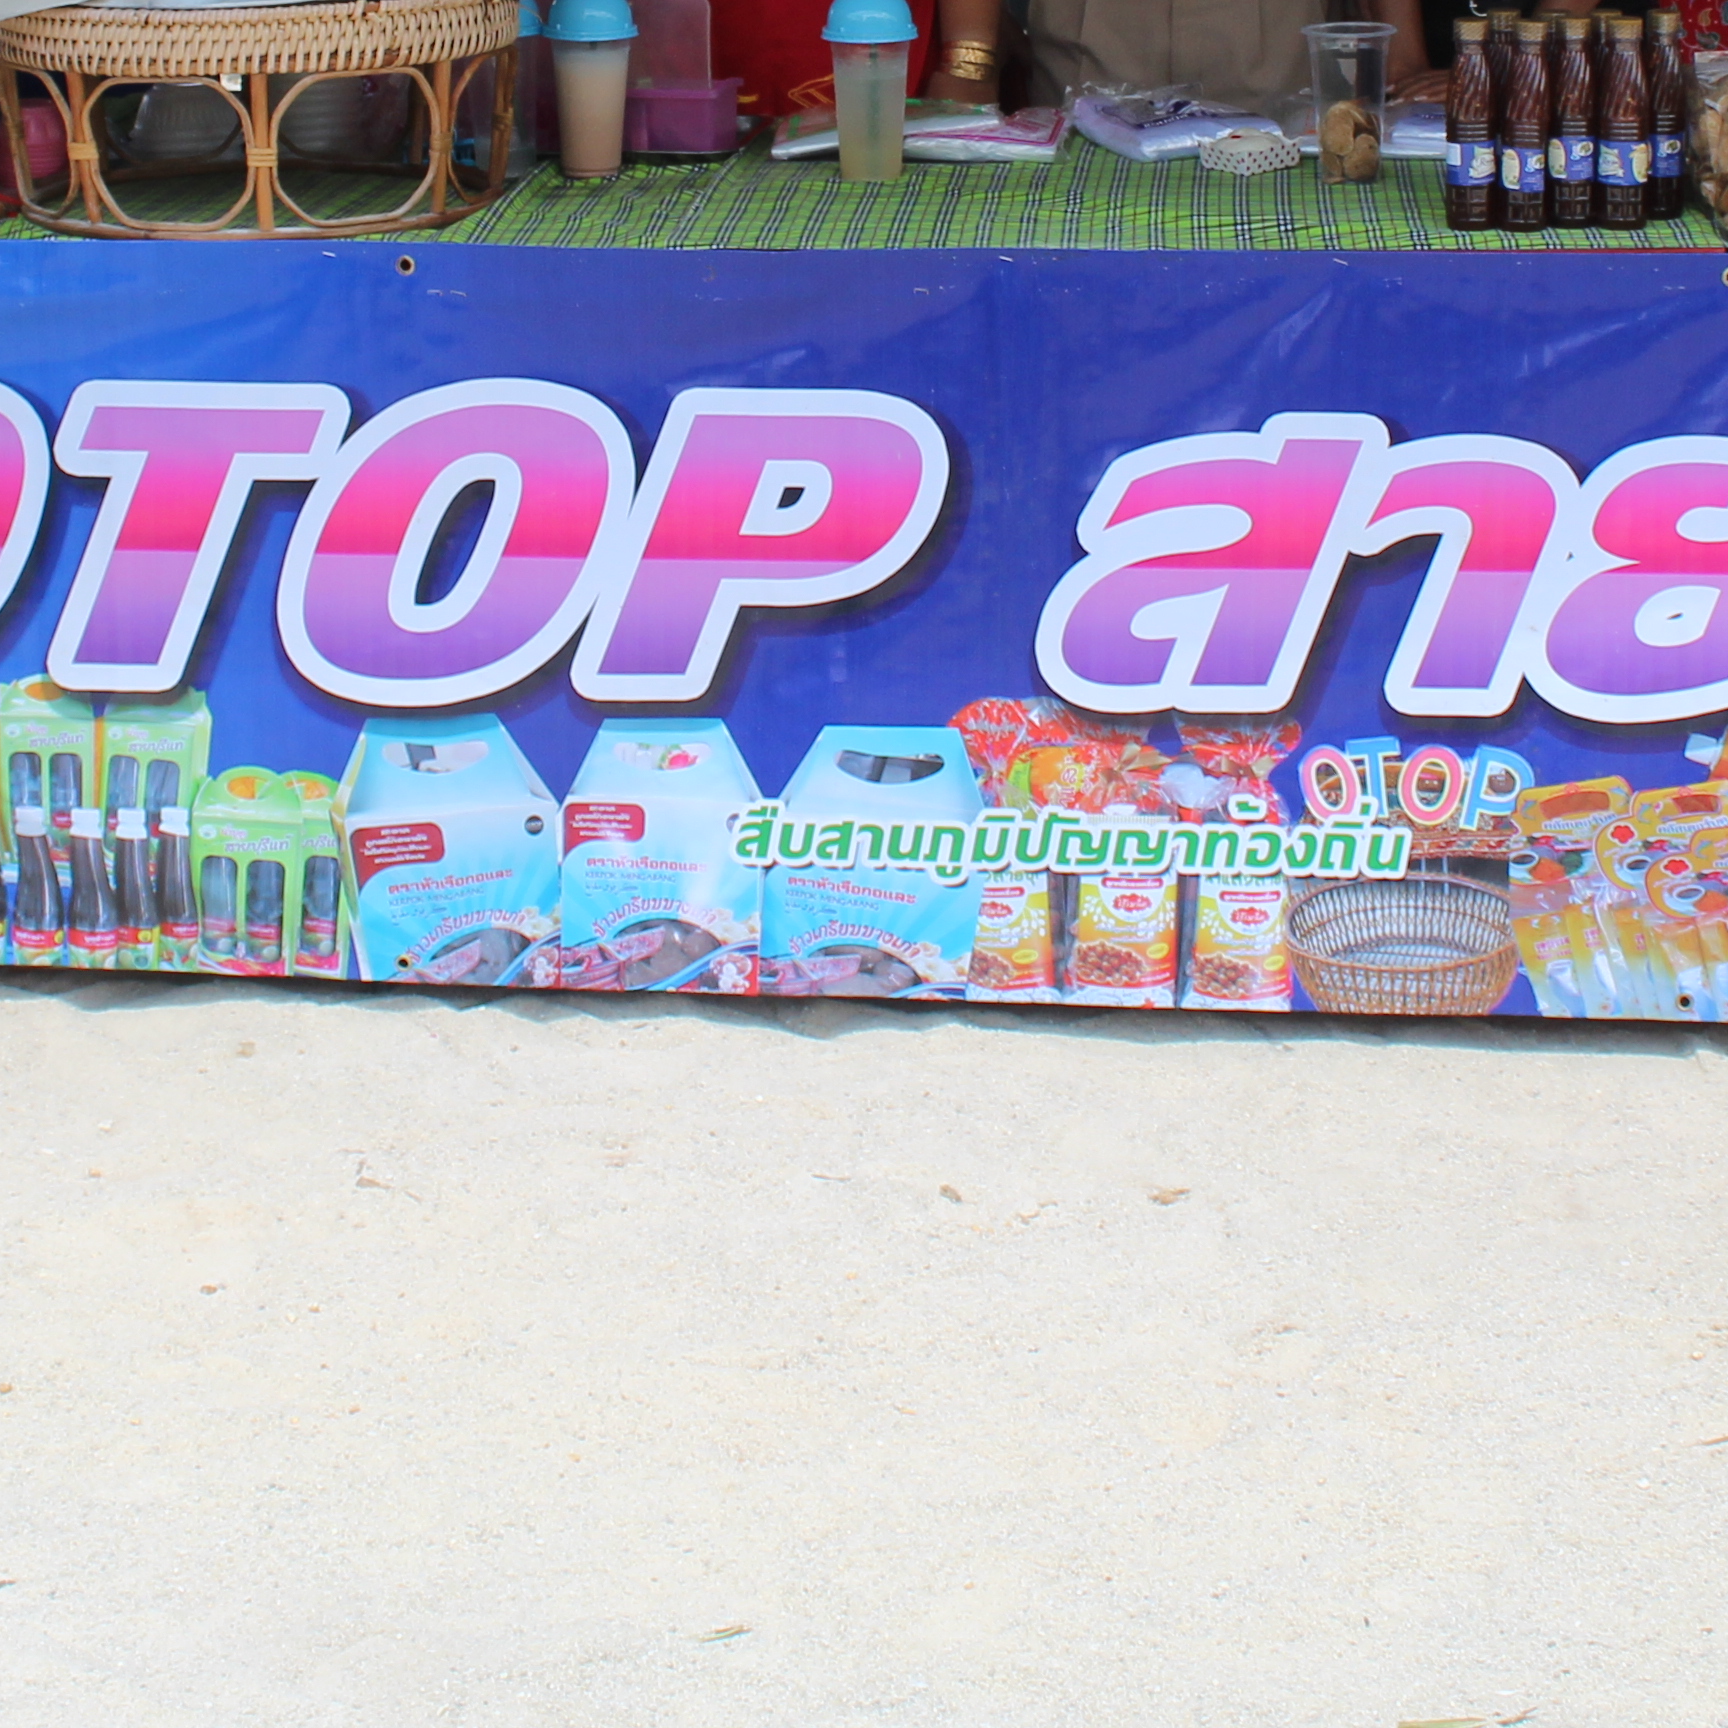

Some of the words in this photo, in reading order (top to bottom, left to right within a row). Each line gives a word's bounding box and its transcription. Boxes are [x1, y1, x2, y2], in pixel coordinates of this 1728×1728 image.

[1298, 736, 1535, 831] OTOP
[733, 797, 1409, 881] สืบสานภูมิปัญญาท้องถิ่น
